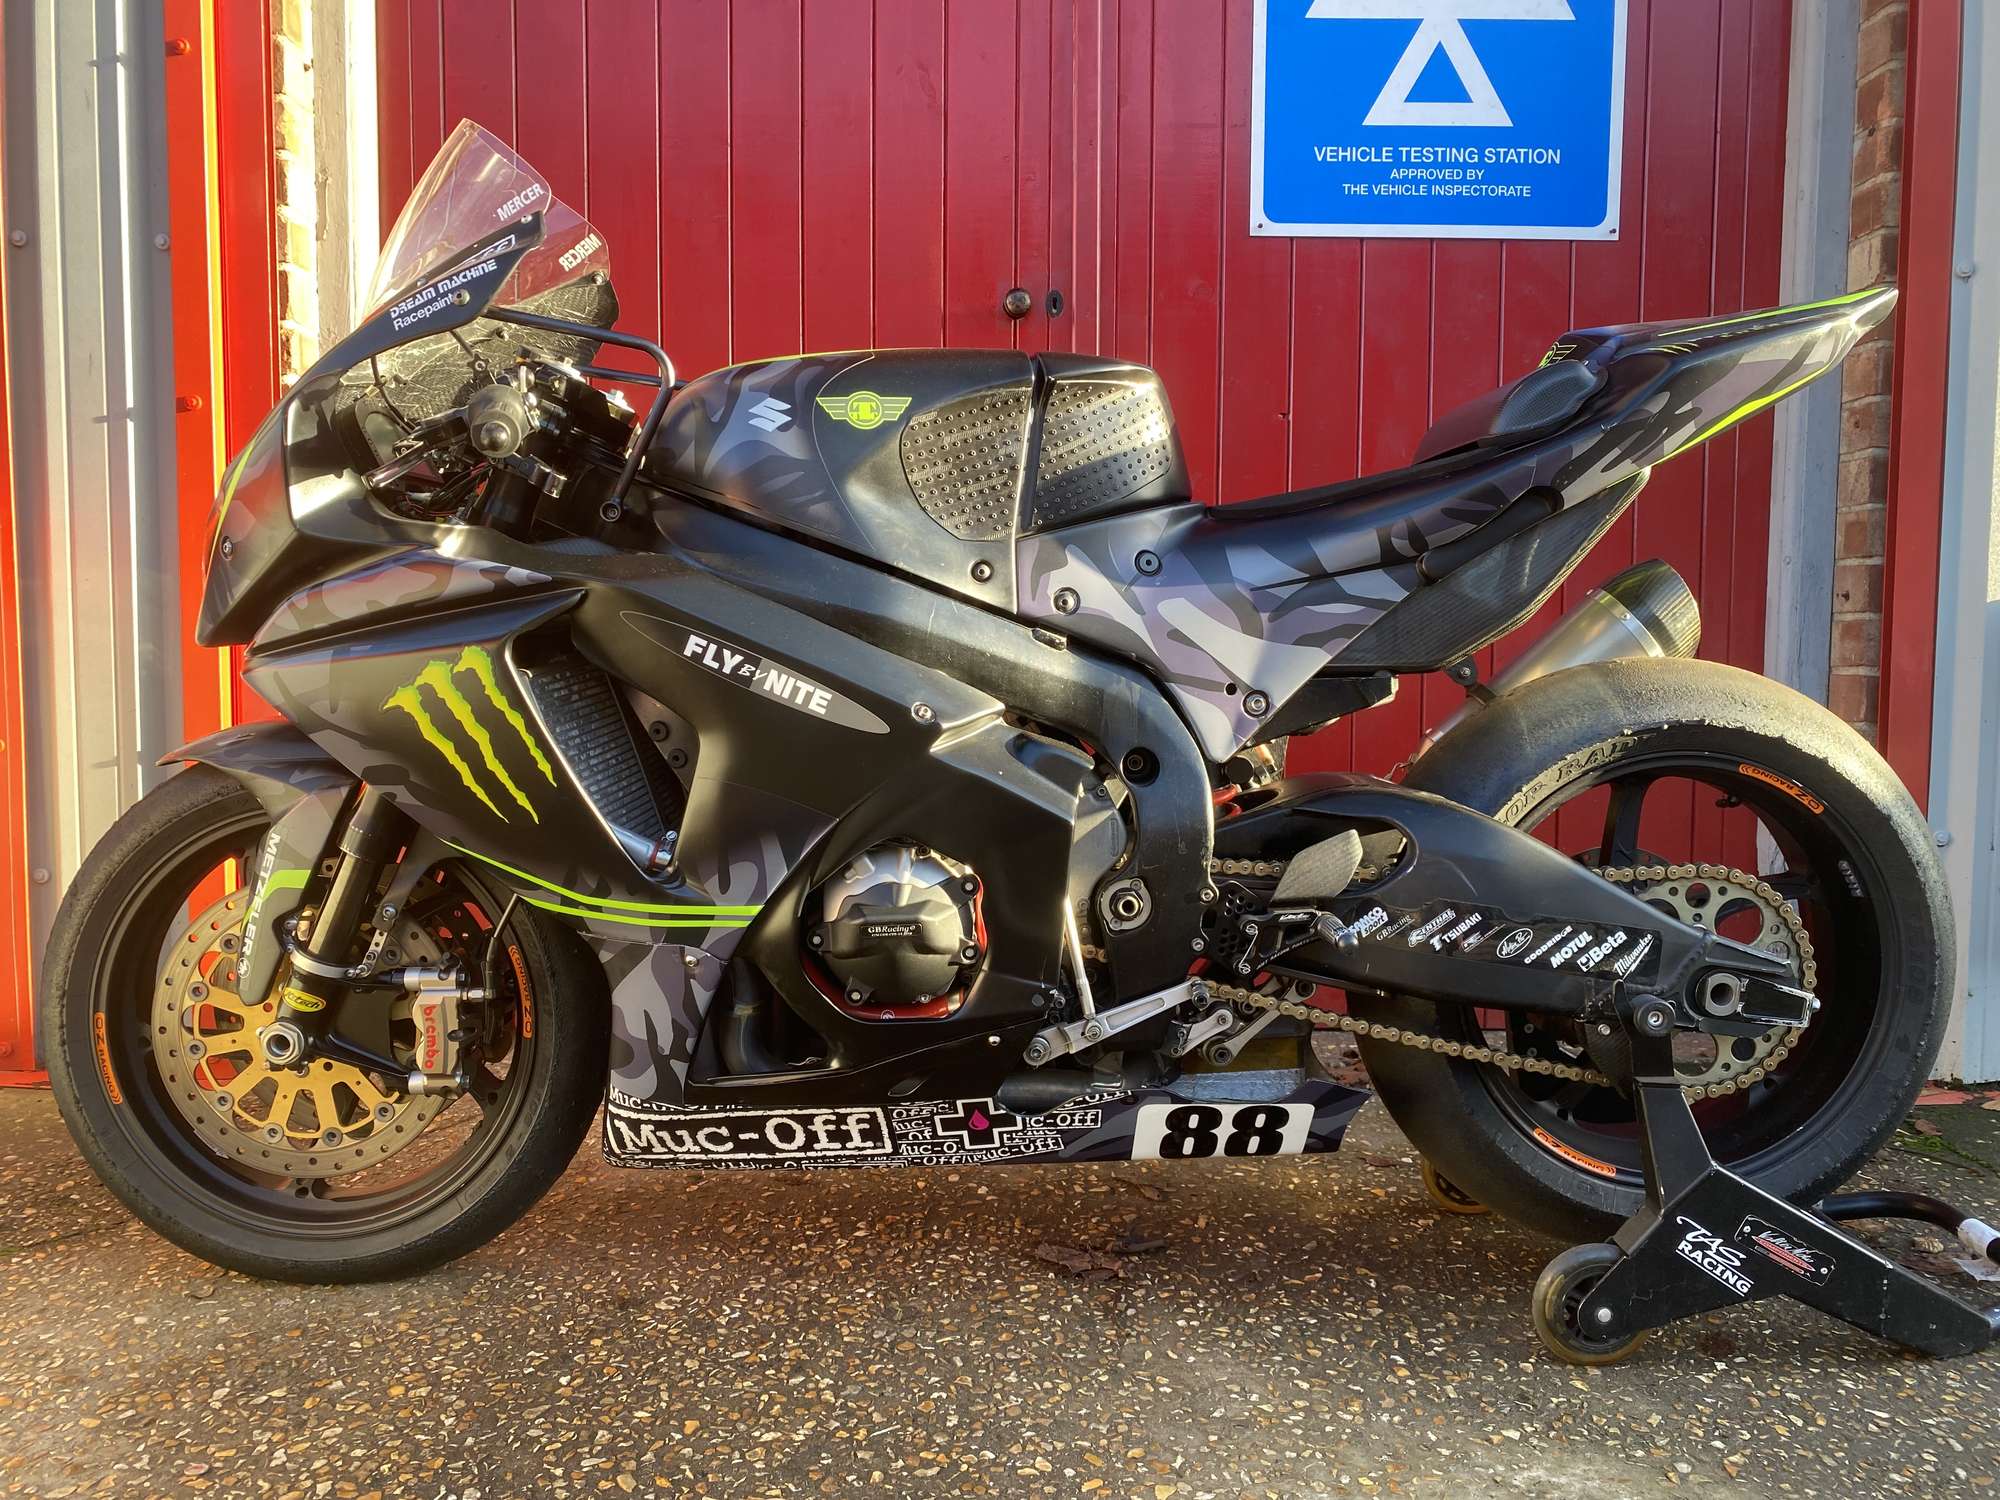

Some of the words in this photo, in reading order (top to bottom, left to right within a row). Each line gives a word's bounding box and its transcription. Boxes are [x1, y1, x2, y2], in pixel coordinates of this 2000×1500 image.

[1314, 146, 1393, 162] VEHICLE
[1398, 147, 1479, 163] TESTING
[1484, 148, 1561, 164] STATION
[1390, 168, 1463, 179] APPROVED
[1466, 169, 1485, 180] BY
[496, 183, 545, 221] MERCER
[1342, 183, 1369, 195] THE
[1372, 184, 1427, 196] VEHICLE
[1431, 185, 1532, 197] INSPECTORATE
[390, 286, 436, 319] DREAM
[683, 633, 744, 675] FLY
[762, 669, 833, 715] NITE
[241, 832, 281, 956] METZELER
[1441, 912, 1483, 943] TSUBAKI
[1550, 930, 1593, 969] MOTUL
[1591, 930, 1628, 964] Beta
[423, 1004, 441, 1070] brembo
[613, 1112, 878, 1153] Muc-Off
[1158, 1104, 1290, 1160] 88
[1676, 1239, 1752, 1295] RACING
